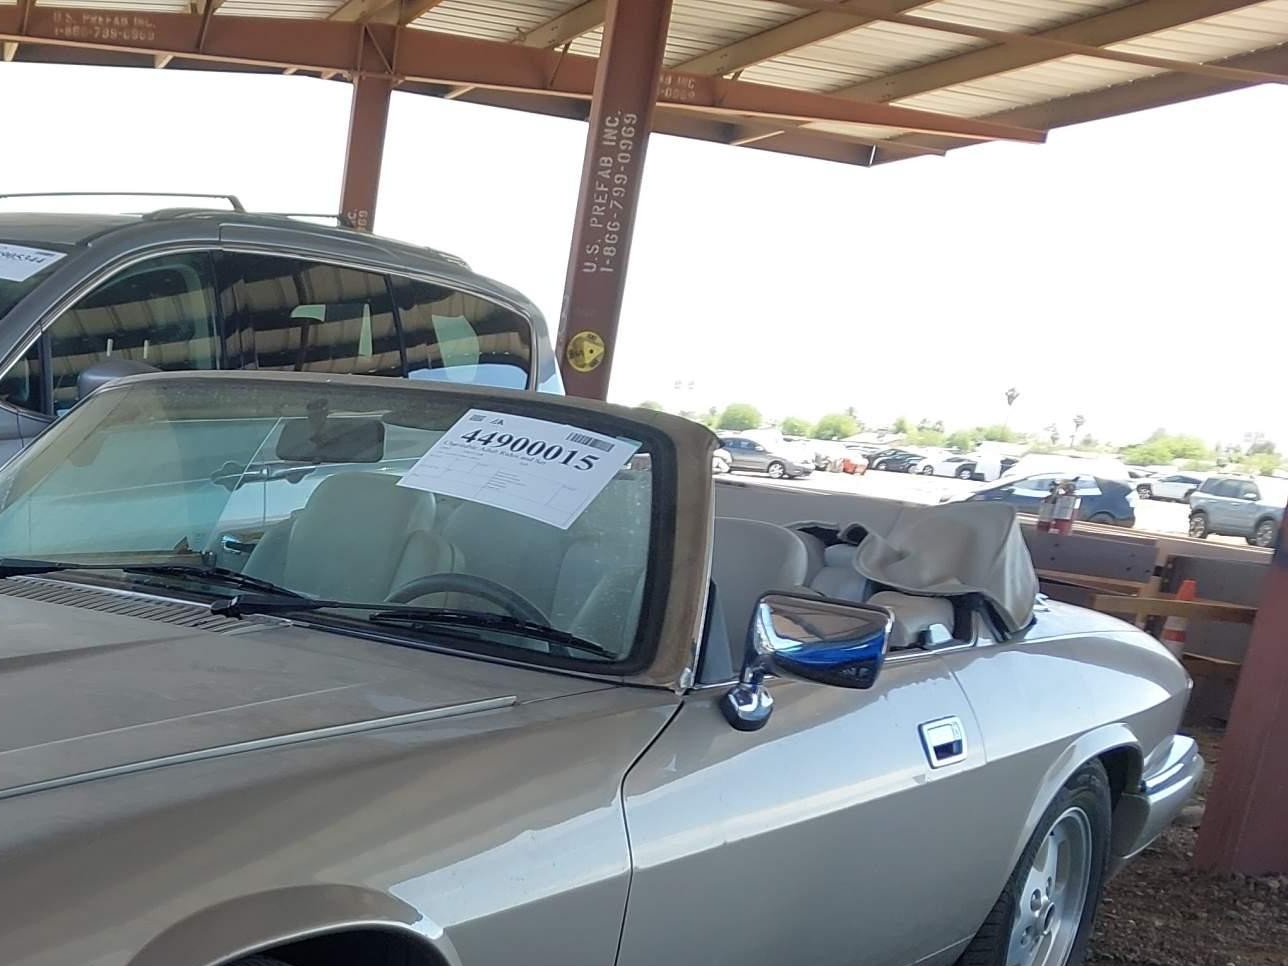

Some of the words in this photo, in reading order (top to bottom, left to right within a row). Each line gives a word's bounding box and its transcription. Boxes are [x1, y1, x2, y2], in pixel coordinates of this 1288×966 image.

[602, 110, 622, 146] INC.
[590, 155, 613, 228] PREFAB
[582, 240, 602, 273] U.S.
[461, 429, 600, 471] 44900015
